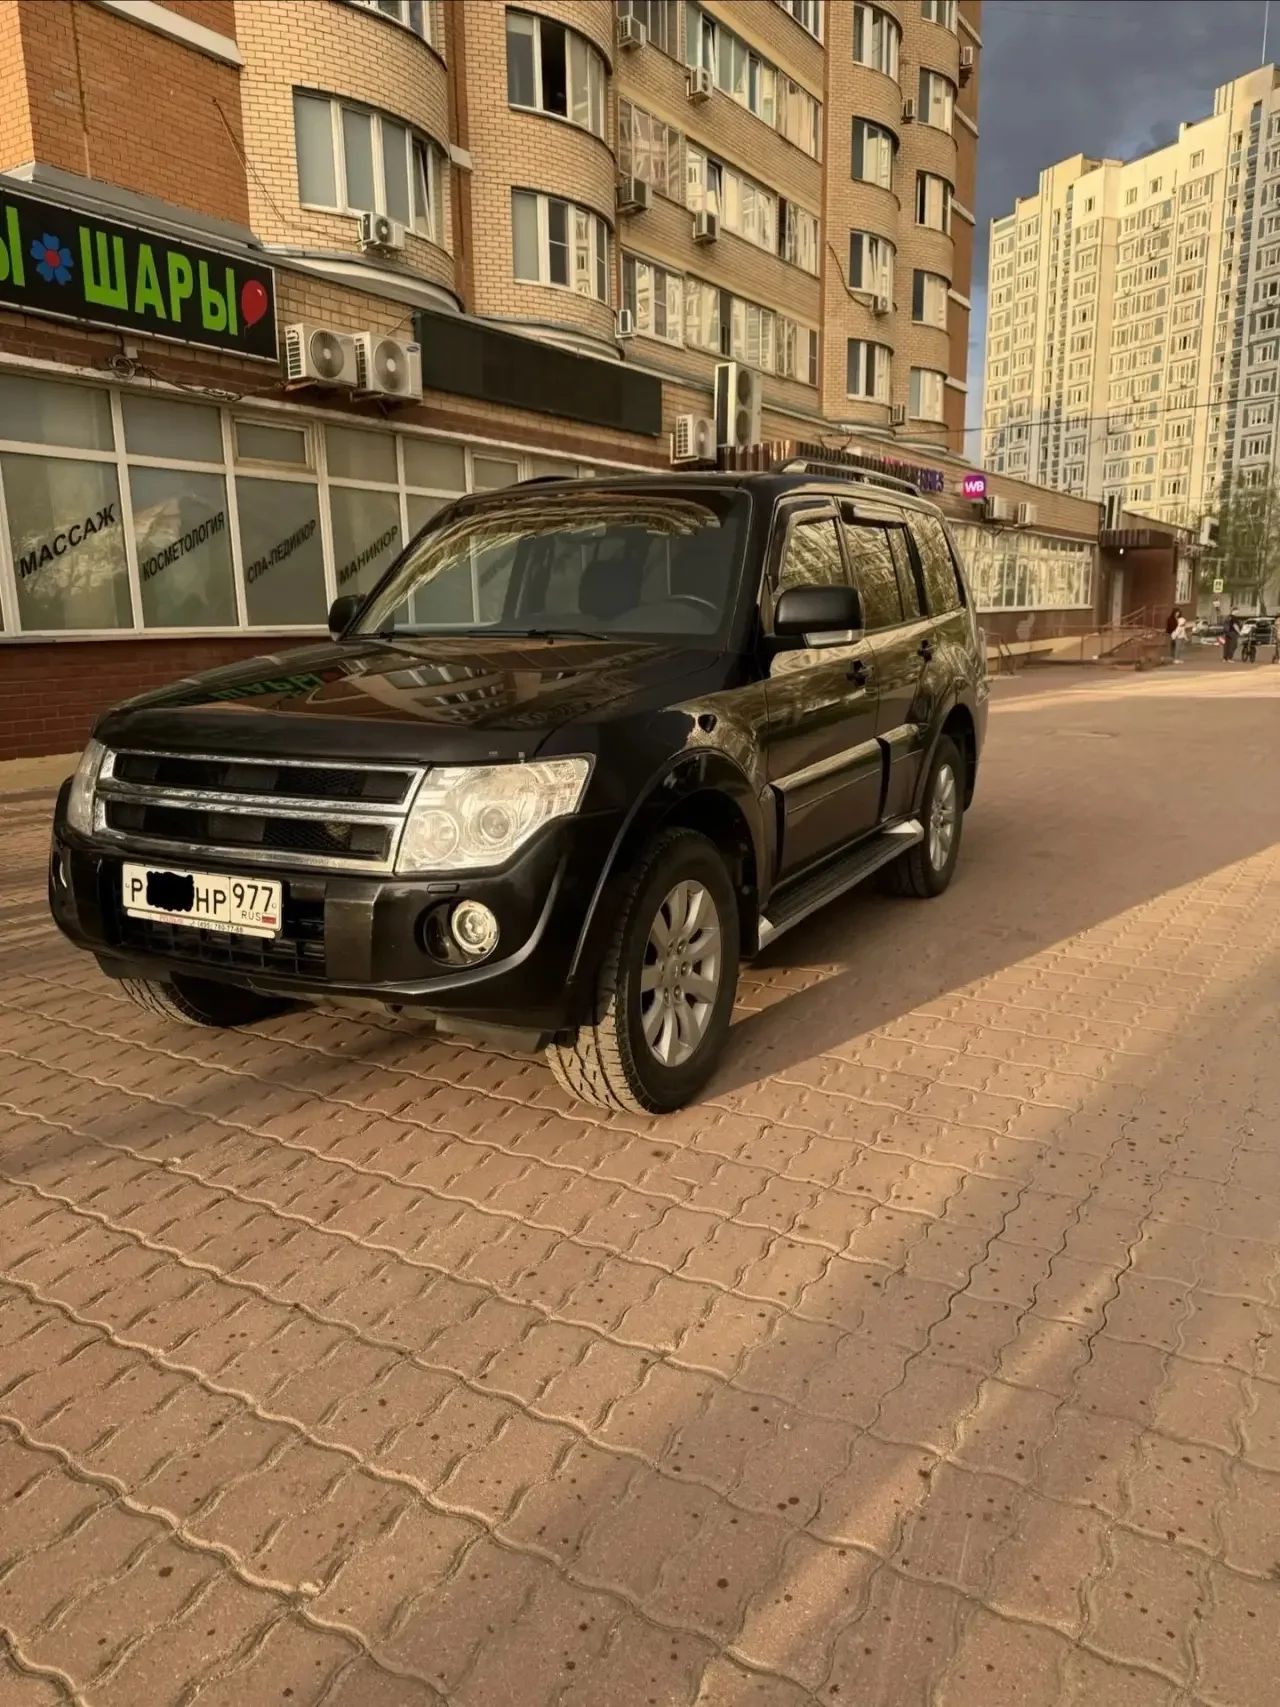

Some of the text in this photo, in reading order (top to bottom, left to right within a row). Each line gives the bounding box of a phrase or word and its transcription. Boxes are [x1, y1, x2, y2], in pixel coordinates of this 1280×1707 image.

[79, 226, 238, 336] ШАРЫ
[965, 480, 985, 493] WB
[19, 503, 115, 578] МАССАЖ
[142, 511, 225, 581] КОСМЕТОЛОГИЯ
[247, 519, 316, 583] СПА-ПЕДИКЮР
[339, 525, 398, 585] МАНИКЮР
[232, 883, 273, 912] 977
[241, 910, 261, 922] RUS
